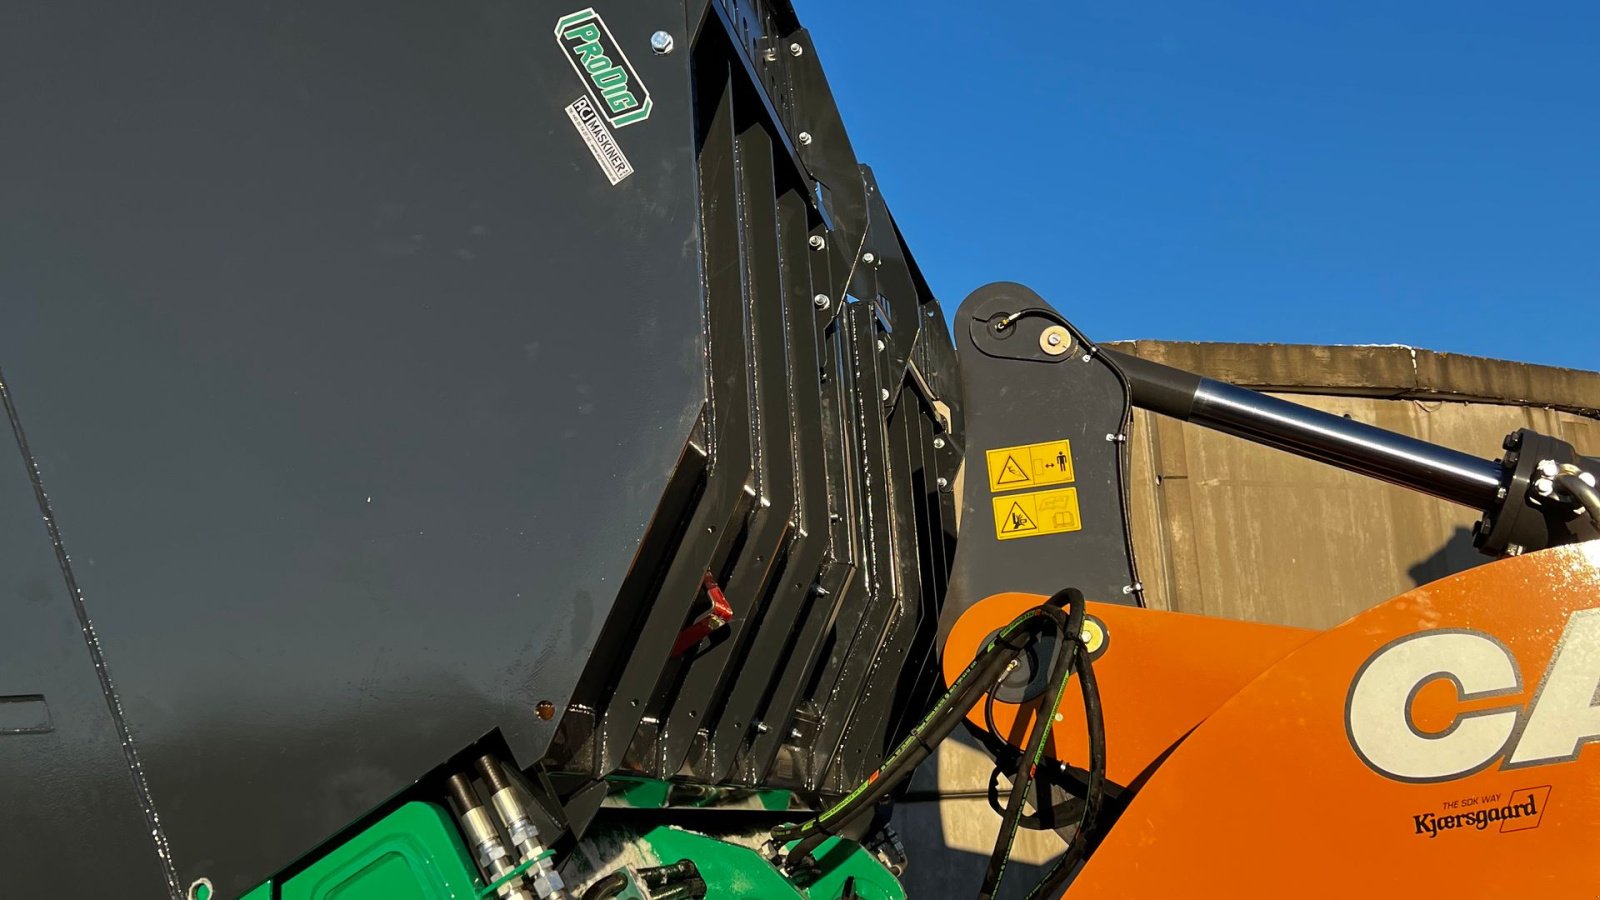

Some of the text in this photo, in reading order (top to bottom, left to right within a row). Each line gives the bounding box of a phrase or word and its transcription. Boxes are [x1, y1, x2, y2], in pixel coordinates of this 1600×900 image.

[573, 99, 596, 121] ACJ
[588, 120, 626, 173] MASKINER
[1413, 794, 1537, 838] Kjærsgaard
[1443, 793, 1502, 810] THE SDK WAY
